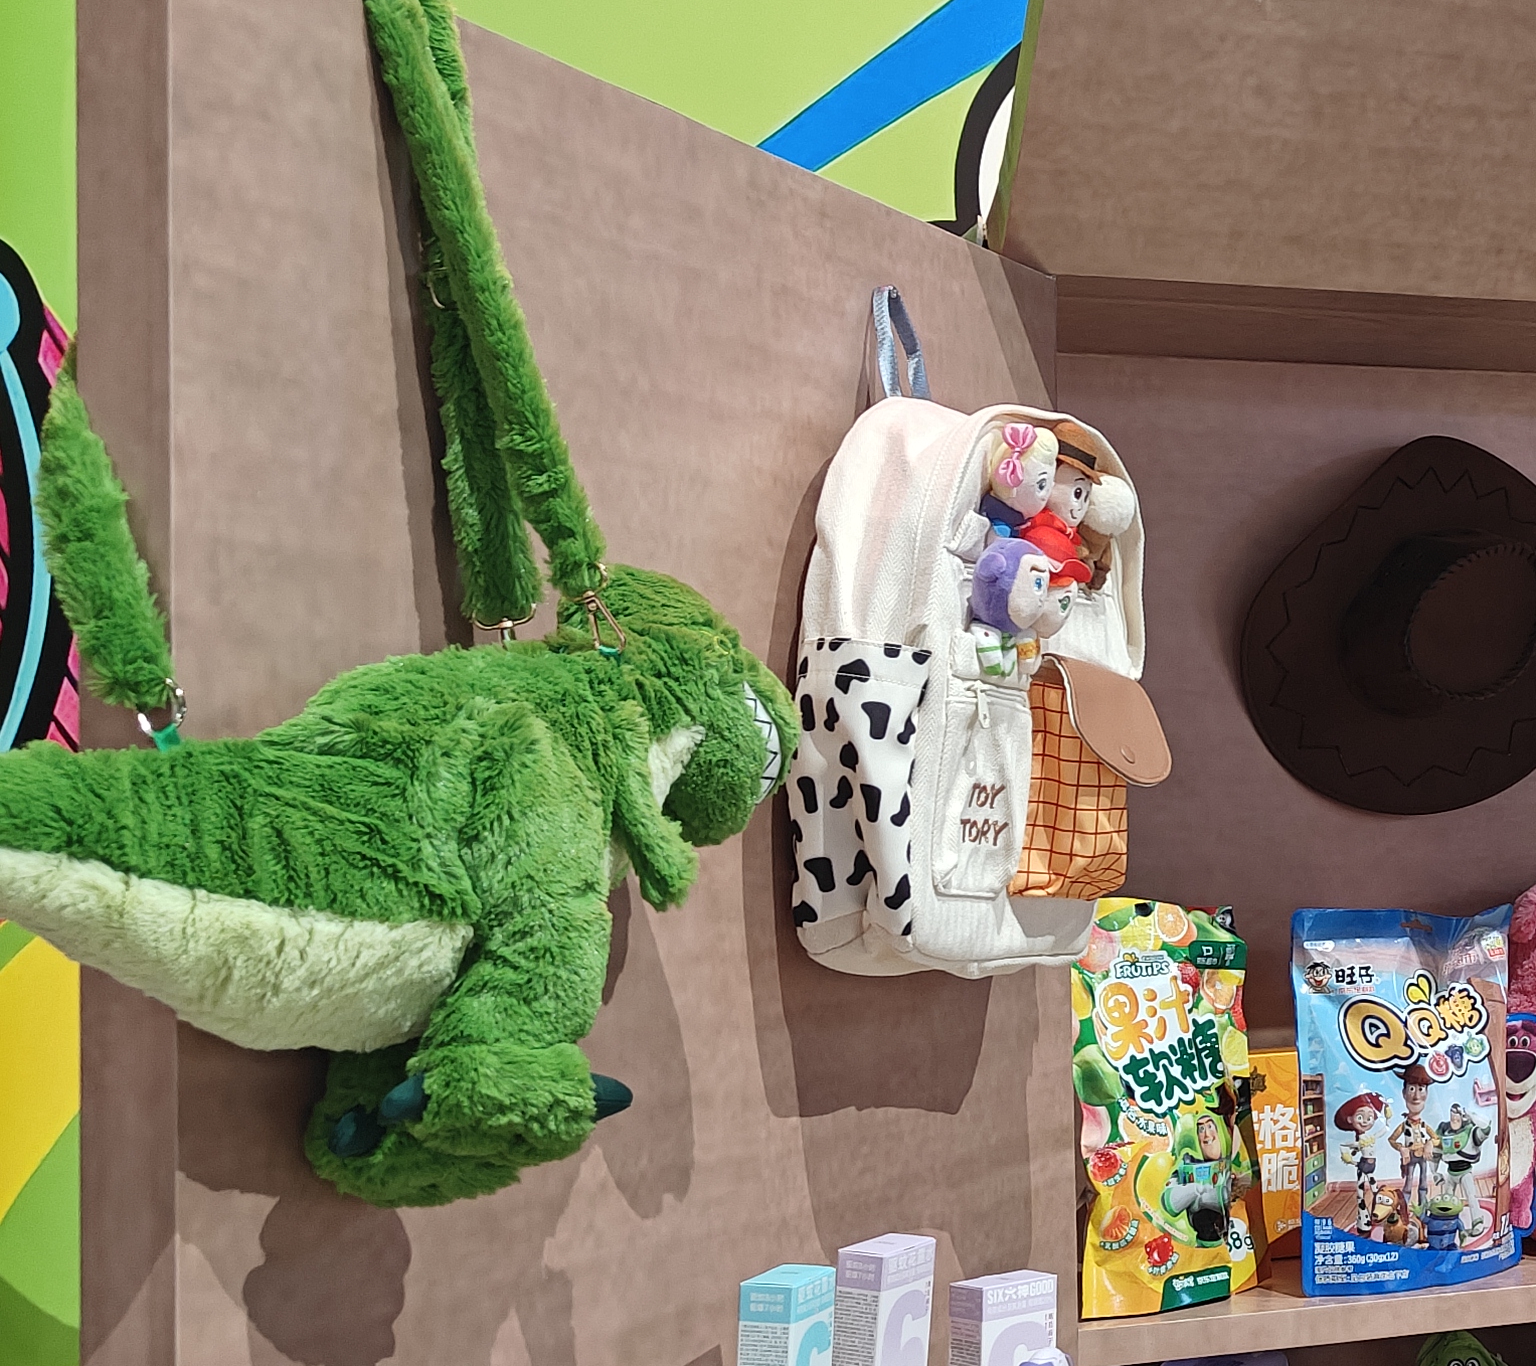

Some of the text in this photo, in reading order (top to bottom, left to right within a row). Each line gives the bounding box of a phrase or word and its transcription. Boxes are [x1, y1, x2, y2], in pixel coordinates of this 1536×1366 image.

[968, 783, 1006, 809] TOY
[960, 819, 1009, 846] TORY
[1114, 961, 1170, 979] FRUTIPS
[1334, 965, 1375, 985] 旺仔
[1099, 975, 1191, 1061] 果汁
[1344, 986, 1482, 1065] QQ糖
[1227, 1230, 1255, 1253] 8g
